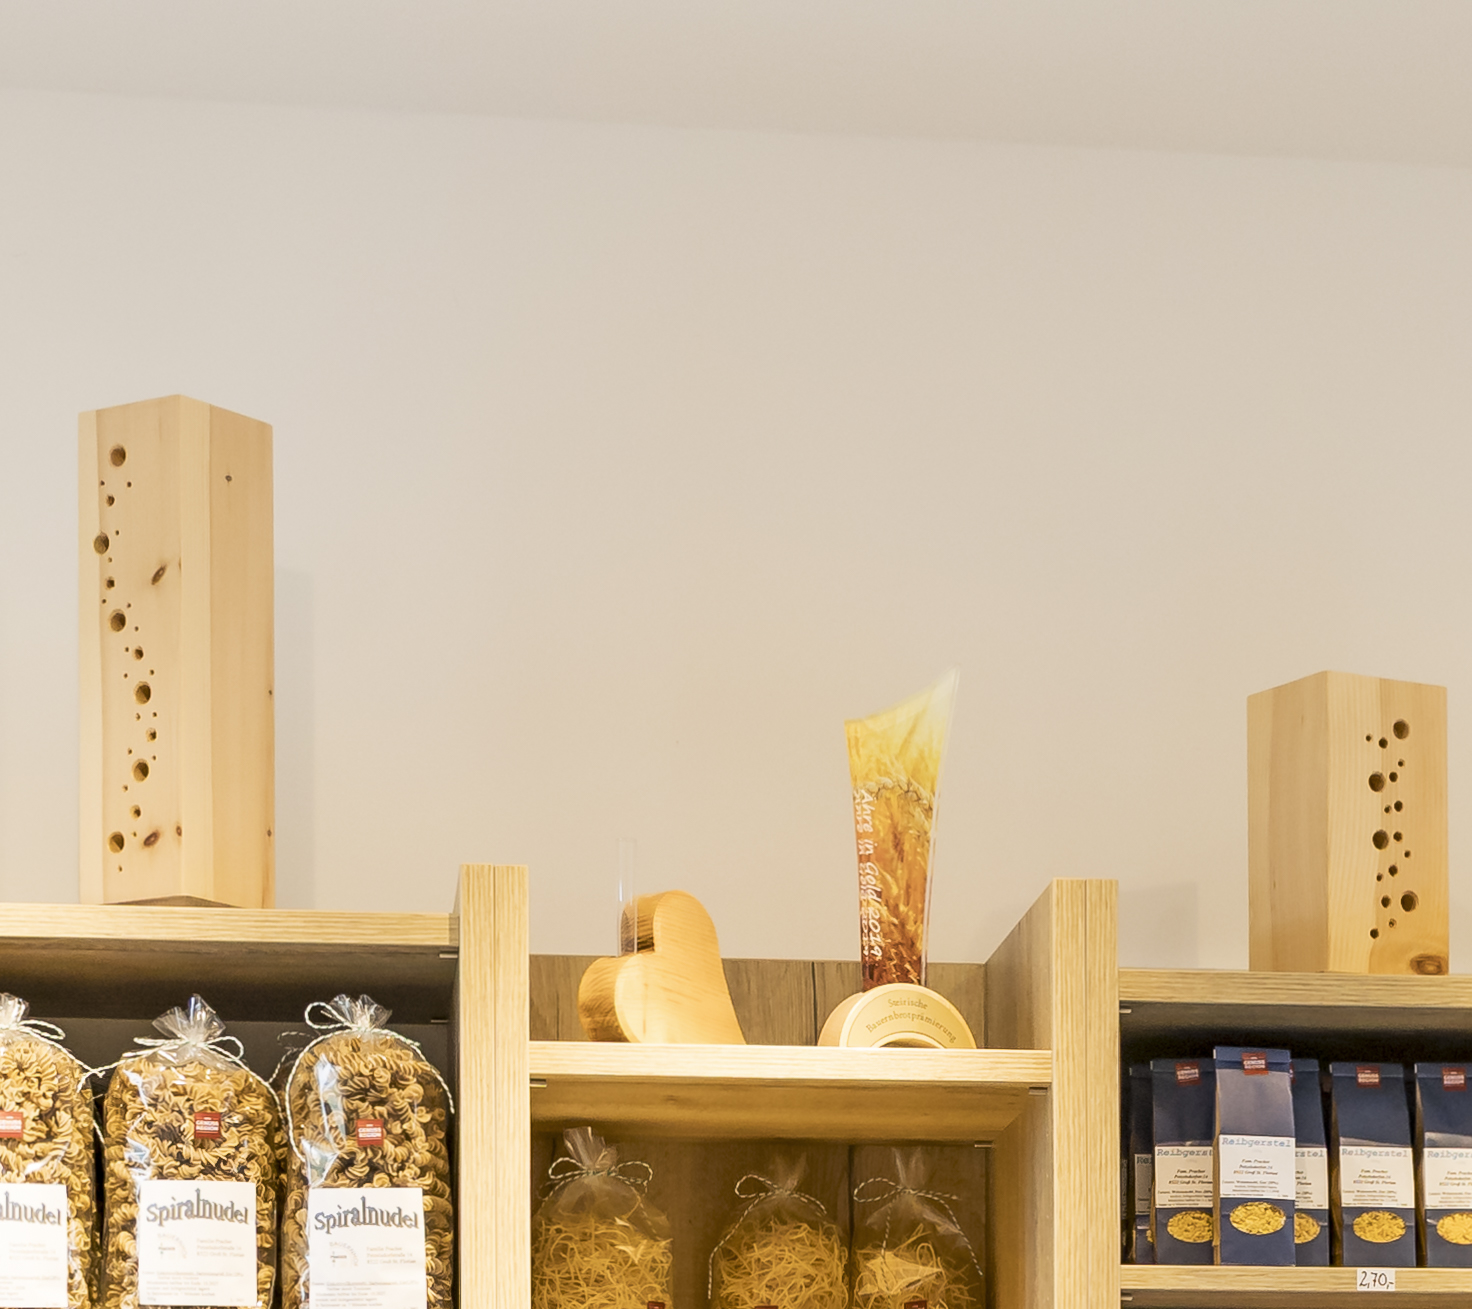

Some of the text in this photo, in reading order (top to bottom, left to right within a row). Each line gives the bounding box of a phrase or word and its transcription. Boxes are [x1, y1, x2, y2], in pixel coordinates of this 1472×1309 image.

[864, 861, 882, 902] Gold
[866, 907, 883, 957] 2019
[1157, 1147, 1213, 1159] Reibgerst
[1221, 1136, 1292, 1149] Reibgerstel
[1341, 1147, 1409, 1160] Reibgerstel
[147, 1188, 249, 1229] Spiralnudel
[314, 1195, 420, 1234] Spiralnudel
